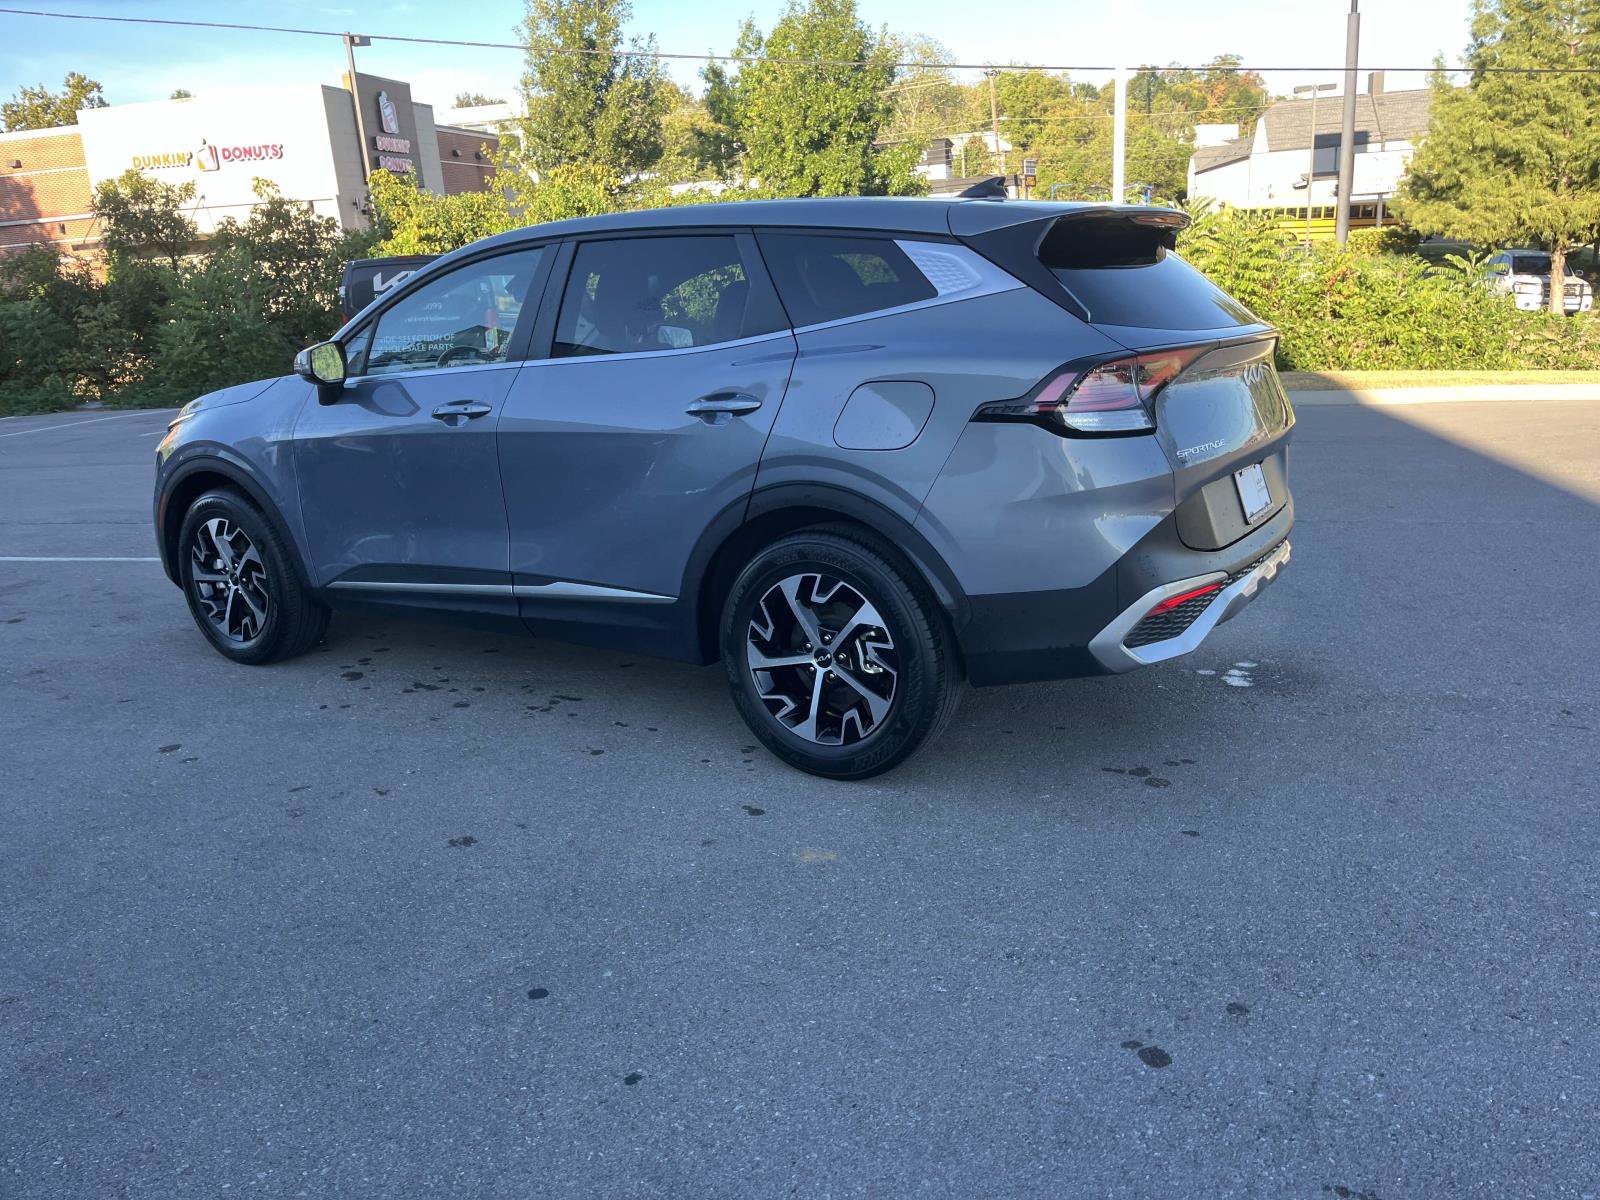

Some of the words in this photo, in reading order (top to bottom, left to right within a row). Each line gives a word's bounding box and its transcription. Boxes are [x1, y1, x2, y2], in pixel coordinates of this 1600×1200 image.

[221, 144, 282, 161] DONUTS
[444, 332, 456, 341] OF
[428, 342, 455, 351] PARTS
[1176, 438, 1225, 458] SPORTAGE
